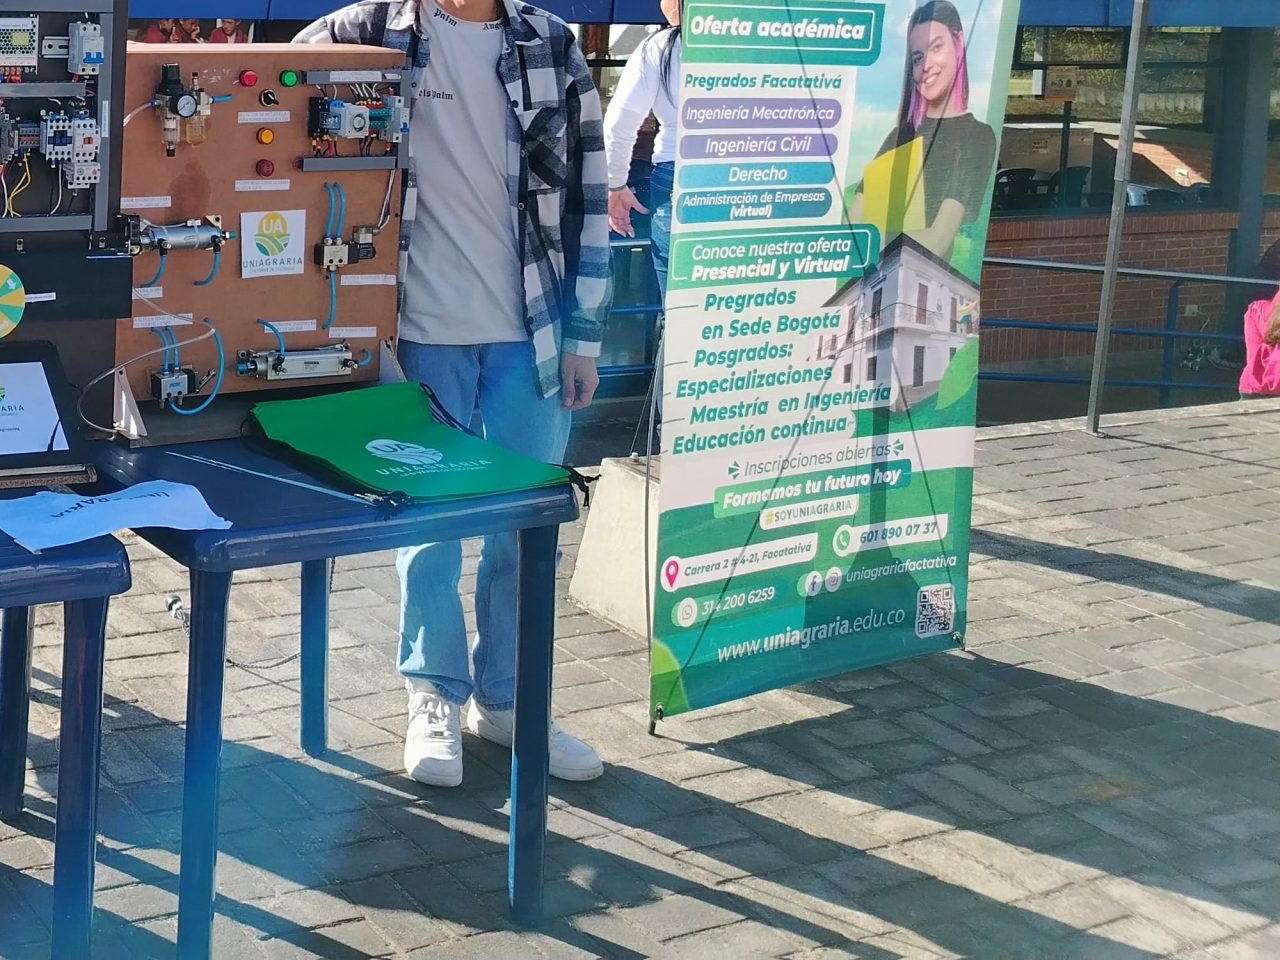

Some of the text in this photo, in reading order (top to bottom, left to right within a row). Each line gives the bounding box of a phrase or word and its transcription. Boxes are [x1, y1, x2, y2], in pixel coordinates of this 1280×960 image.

[690, 16, 866, 40] Oferta académica
[684, 73, 842, 91] Pregrados Facatativá
[686, 105, 835, 123] Ingeniería Mecatrónica
[705, 136, 812, 156] Ingeniería Civil
[728, 166, 788, 182] Derecho
[682, 191, 825, 206] Administración de Empresas
[729, 205, 772, 220] (virtual)
[262, 219, 284, 234] UA
[692, 237, 851, 260] Conoce nuestra oferta
[243, 257, 303, 268] UNIAGRARIA
[691, 255, 850, 282] Presencial y Virtual
[704, 288, 796, 313] Pregrados
[701, 310, 841, 340] en Sede Bogotá
[693, 342, 793, 368] Posgrados:
[675, 365, 833, 401] Especializaciones
[689, 382, 892, 424] Maestría en Ingeniería
[672, 416, 848, 455] Educación continua
[375, 460, 493, 475] UNIAGRARIA
[744, 443, 891, 477] Inscripciones abiertas
[722, 467, 902, 509] Formamos tu futuro hoy
[765, 499, 852, 525] #SOYUNIAGRARIA
[860, 521, 938, 544] 601 890 07 37
[684, 561, 721, 577] Carrera
[722, 559, 729, 568] 2
[740, 552, 760, 564] 4-21,
[762, 541, 812, 561] Facatativá
[846, 554, 957, 583] uniagrariafactativa
[701, 586, 776, 615] 314 200 6259
[717, 608, 906, 663] www.uniagraria.edu.co
